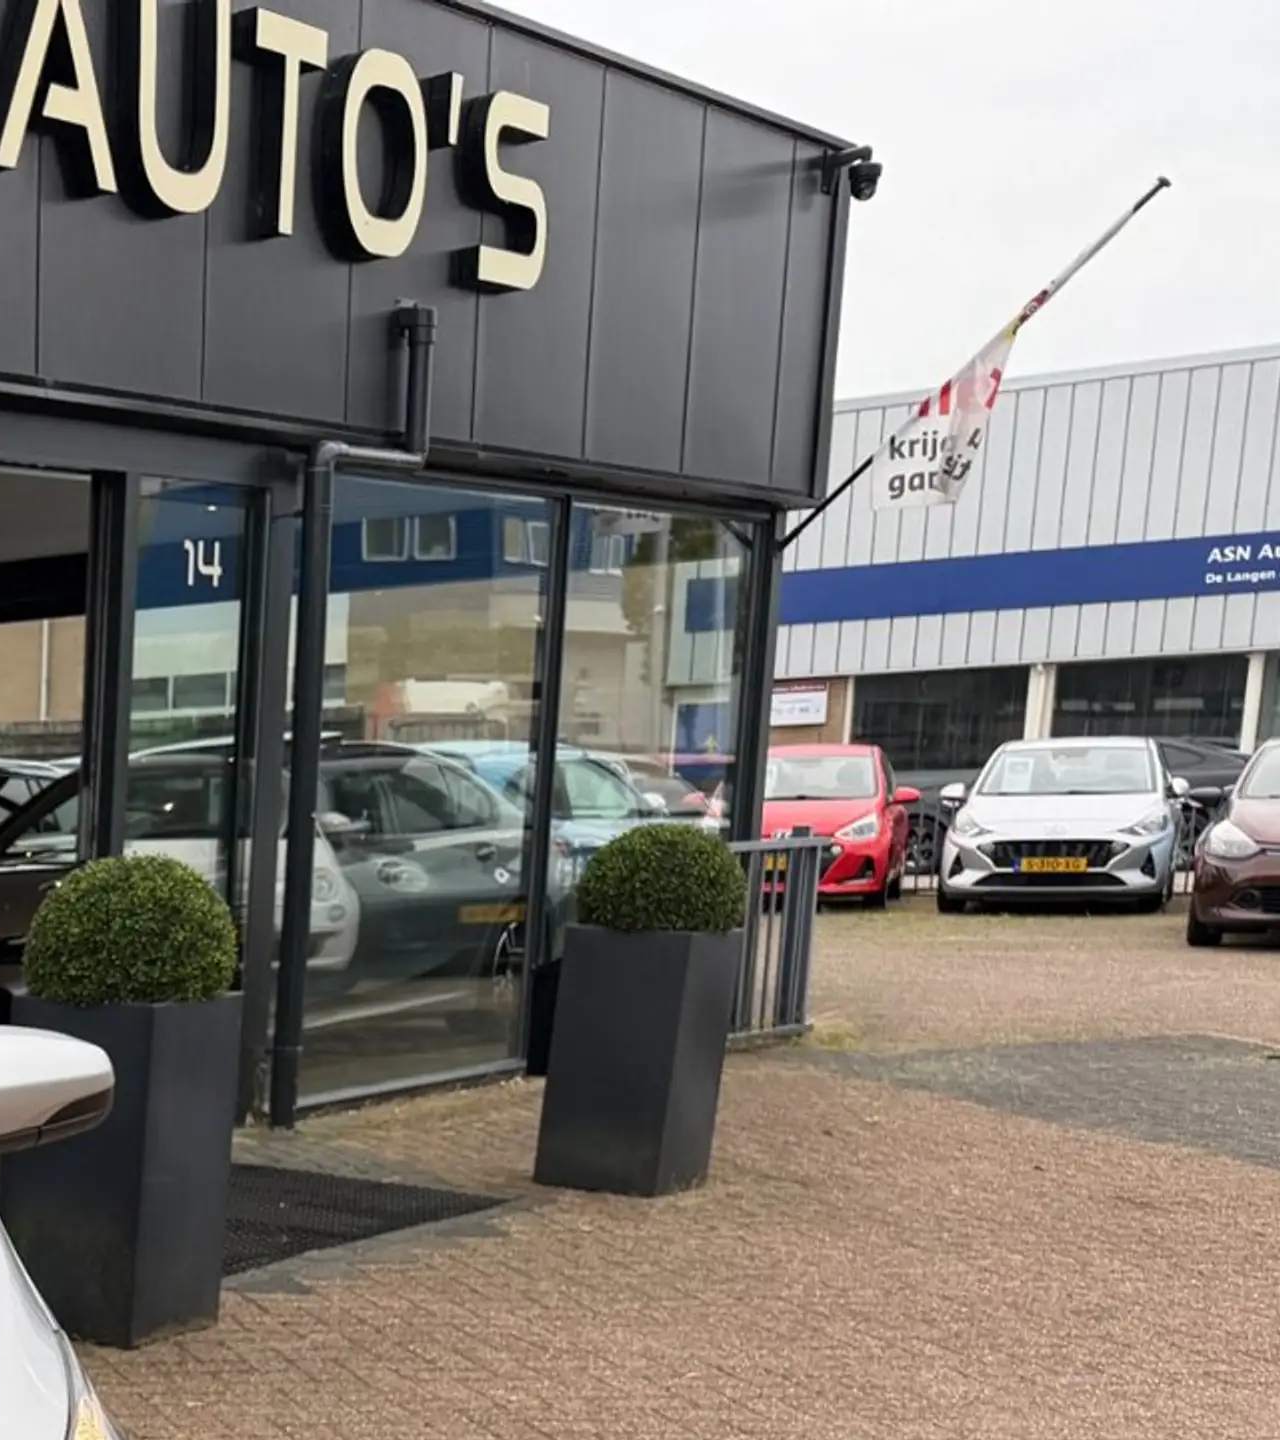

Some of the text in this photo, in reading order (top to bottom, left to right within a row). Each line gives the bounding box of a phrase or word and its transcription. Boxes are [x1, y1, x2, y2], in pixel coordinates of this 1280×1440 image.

[183, 537, 224, 588] 14
[1207, 544, 1252, 564] ASN
[1205, 570, 1276, 584] De Langen
